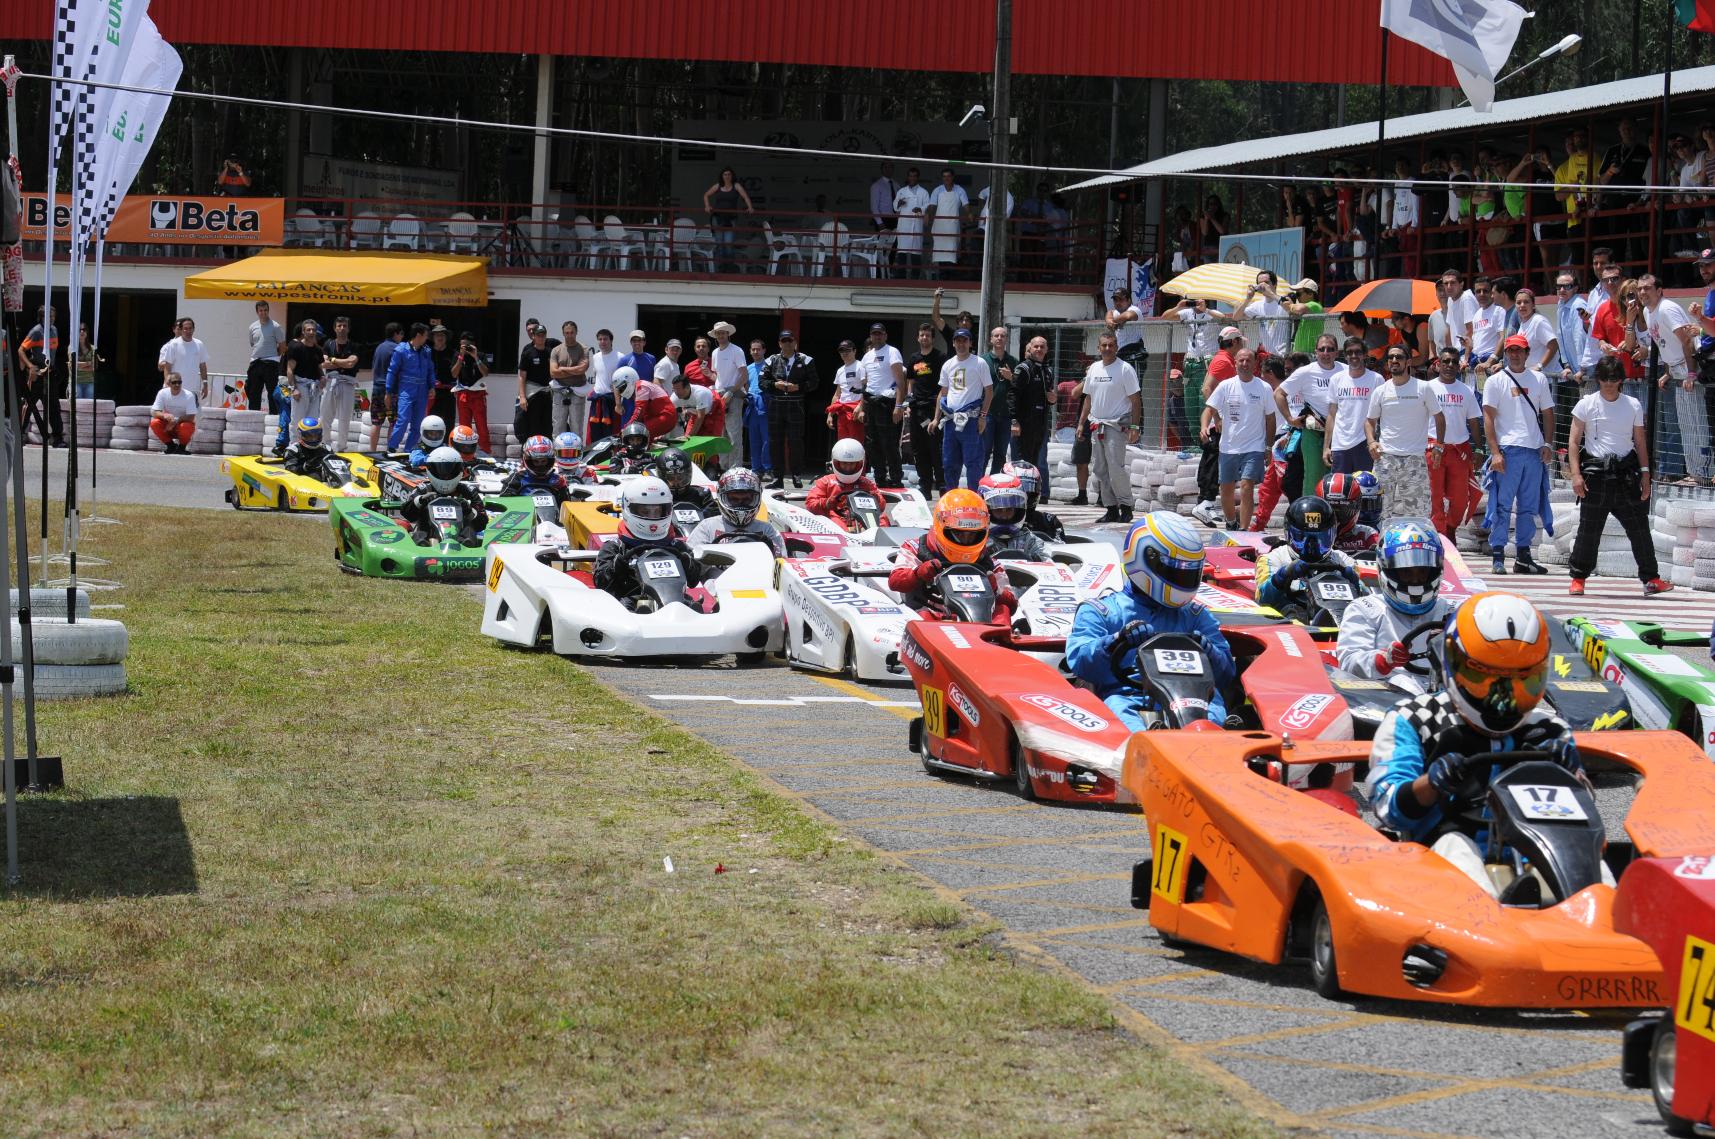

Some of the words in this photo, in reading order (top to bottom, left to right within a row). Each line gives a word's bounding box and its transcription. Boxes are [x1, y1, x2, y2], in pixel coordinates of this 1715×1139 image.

[28, 198, 72, 228] Be
[181, 202, 260, 232] Beta
[1337, 387, 1370, 397] UNITRIP
[1437, 394, 1464, 404] NITRIP
[1306, 513, 1320, 525] tvi
[447, 561, 480, 573] JOGOS
[1323, 583, 1348, 592] 99
[1161, 651, 1197, 662] 39
[925, 690, 941, 734] 39
[1523, 787, 1560, 802] 17
[1155, 831, 1182, 893] 17
